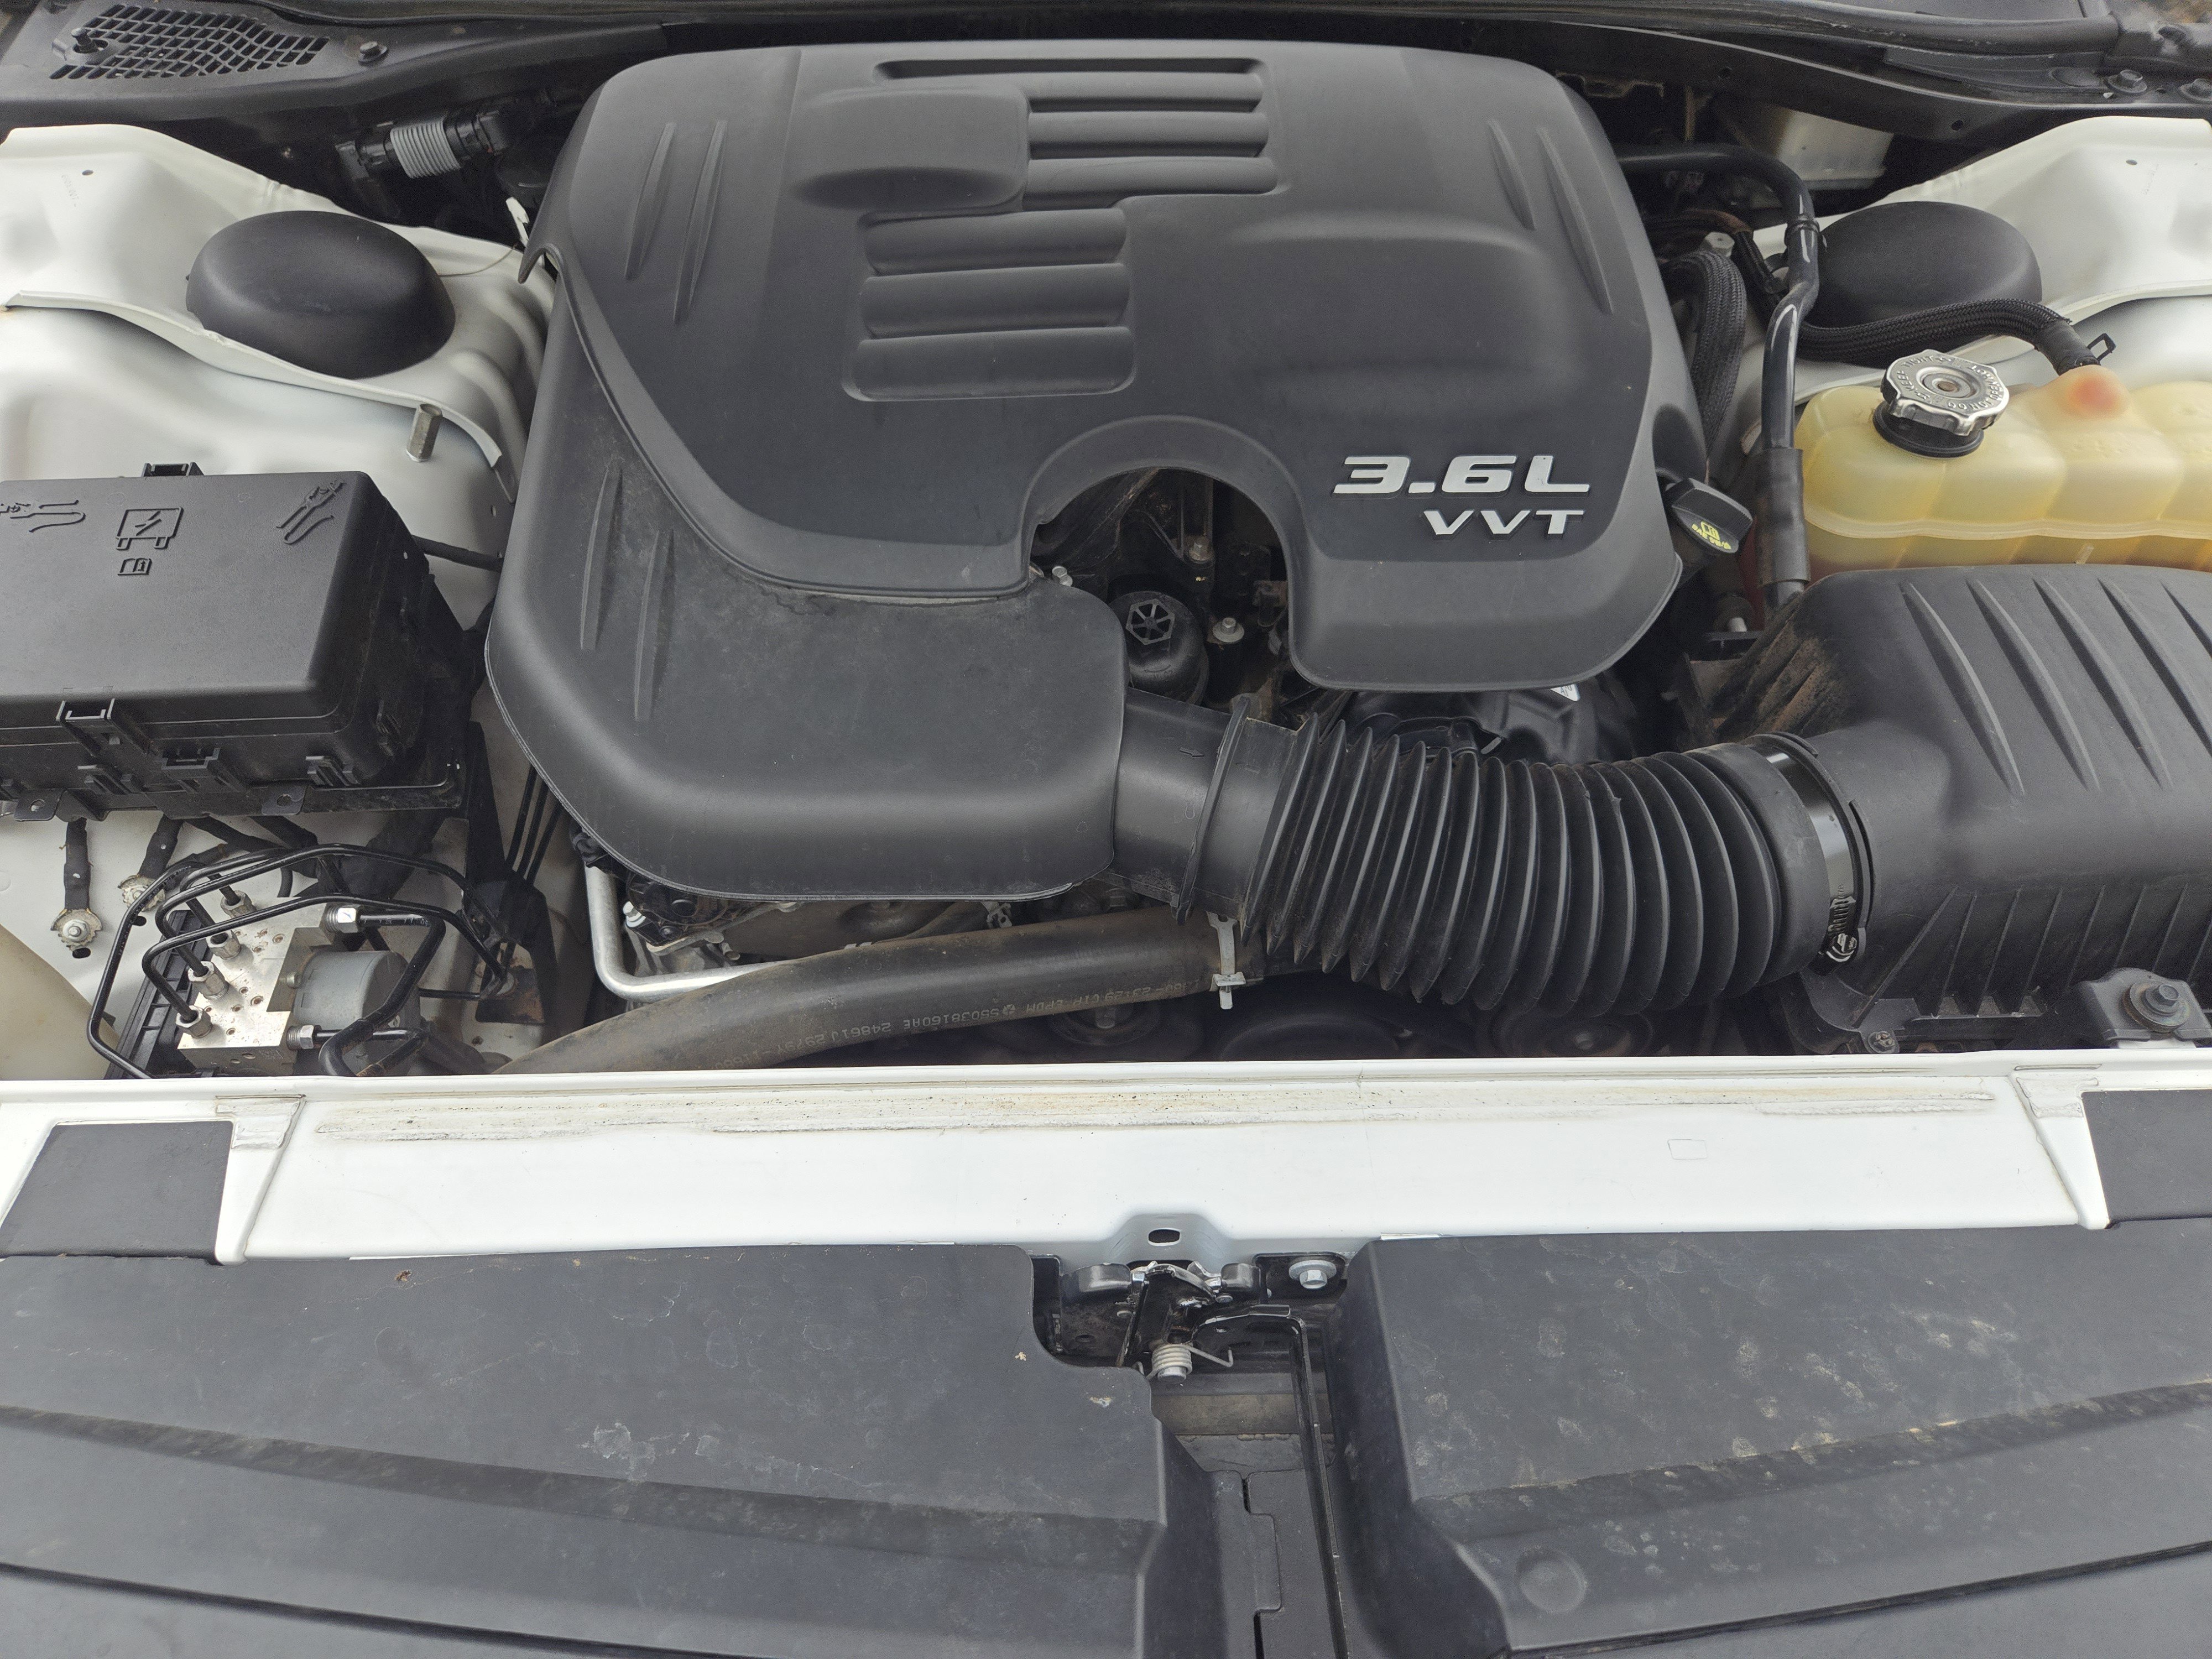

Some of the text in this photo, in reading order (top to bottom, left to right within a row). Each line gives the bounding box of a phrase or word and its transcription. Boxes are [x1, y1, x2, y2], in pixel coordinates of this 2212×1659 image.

[1332, 455, 1590, 495] 3.6L
[1422, 509, 1584, 535] VVT
[903, 1008, 1000, 1029] 55038160AE
